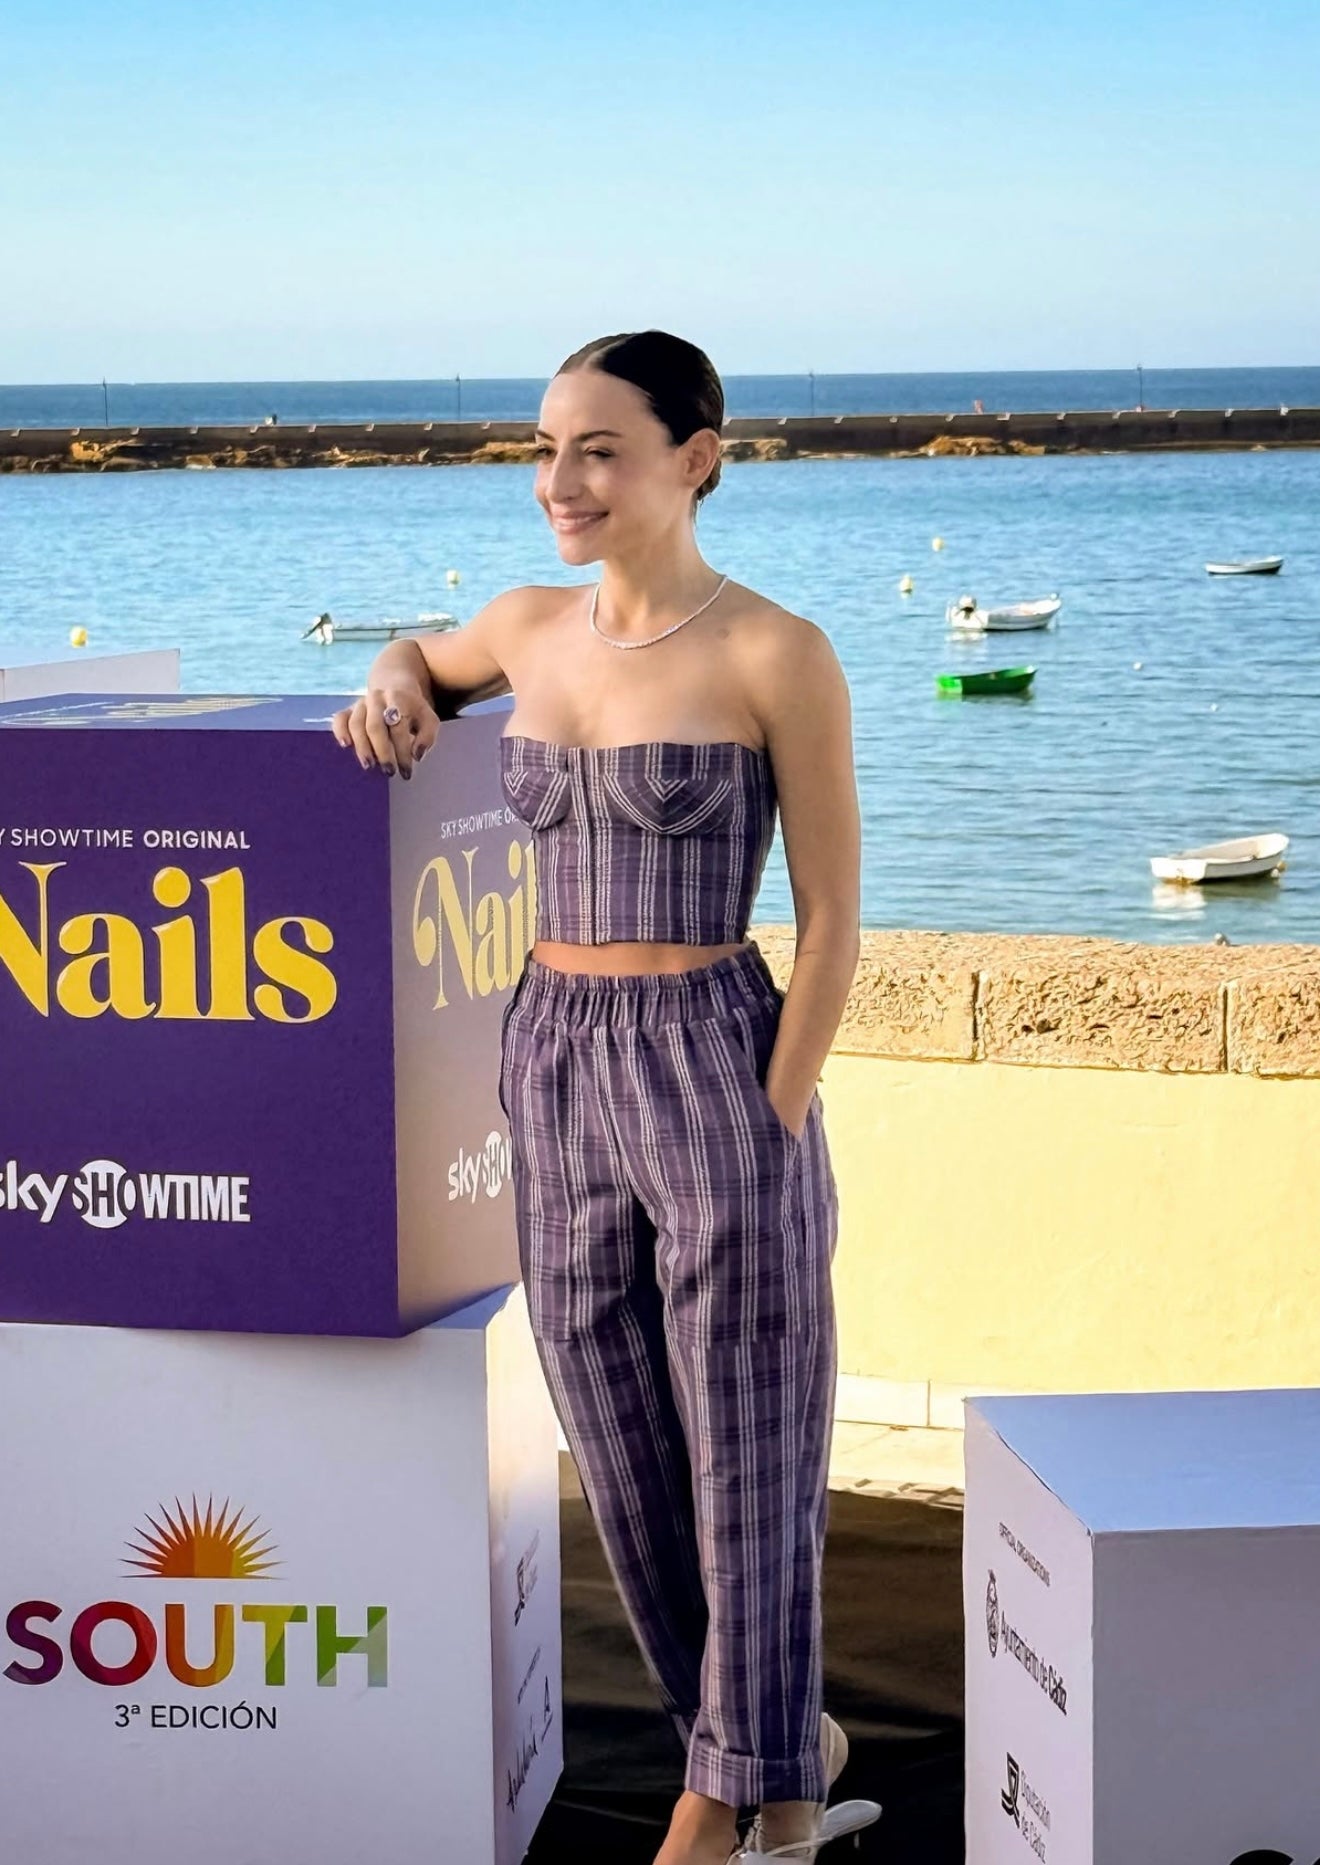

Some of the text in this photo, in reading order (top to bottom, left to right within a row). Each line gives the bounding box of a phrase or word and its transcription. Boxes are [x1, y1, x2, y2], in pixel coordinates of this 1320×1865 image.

[10, 828, 134, 848] SHOWTIME
[143, 829, 251, 849] ORIGINAL
[441, 821, 457, 839] SKY
[458, 809, 503, 836] SHOWTIME
[413, 839, 537, 1010] Nail
[0, 1160, 69, 1223] ky
[2, 1600, 389, 1688] SOUTH
[114, 1700, 277, 1729] 3ª EDICIÓN
